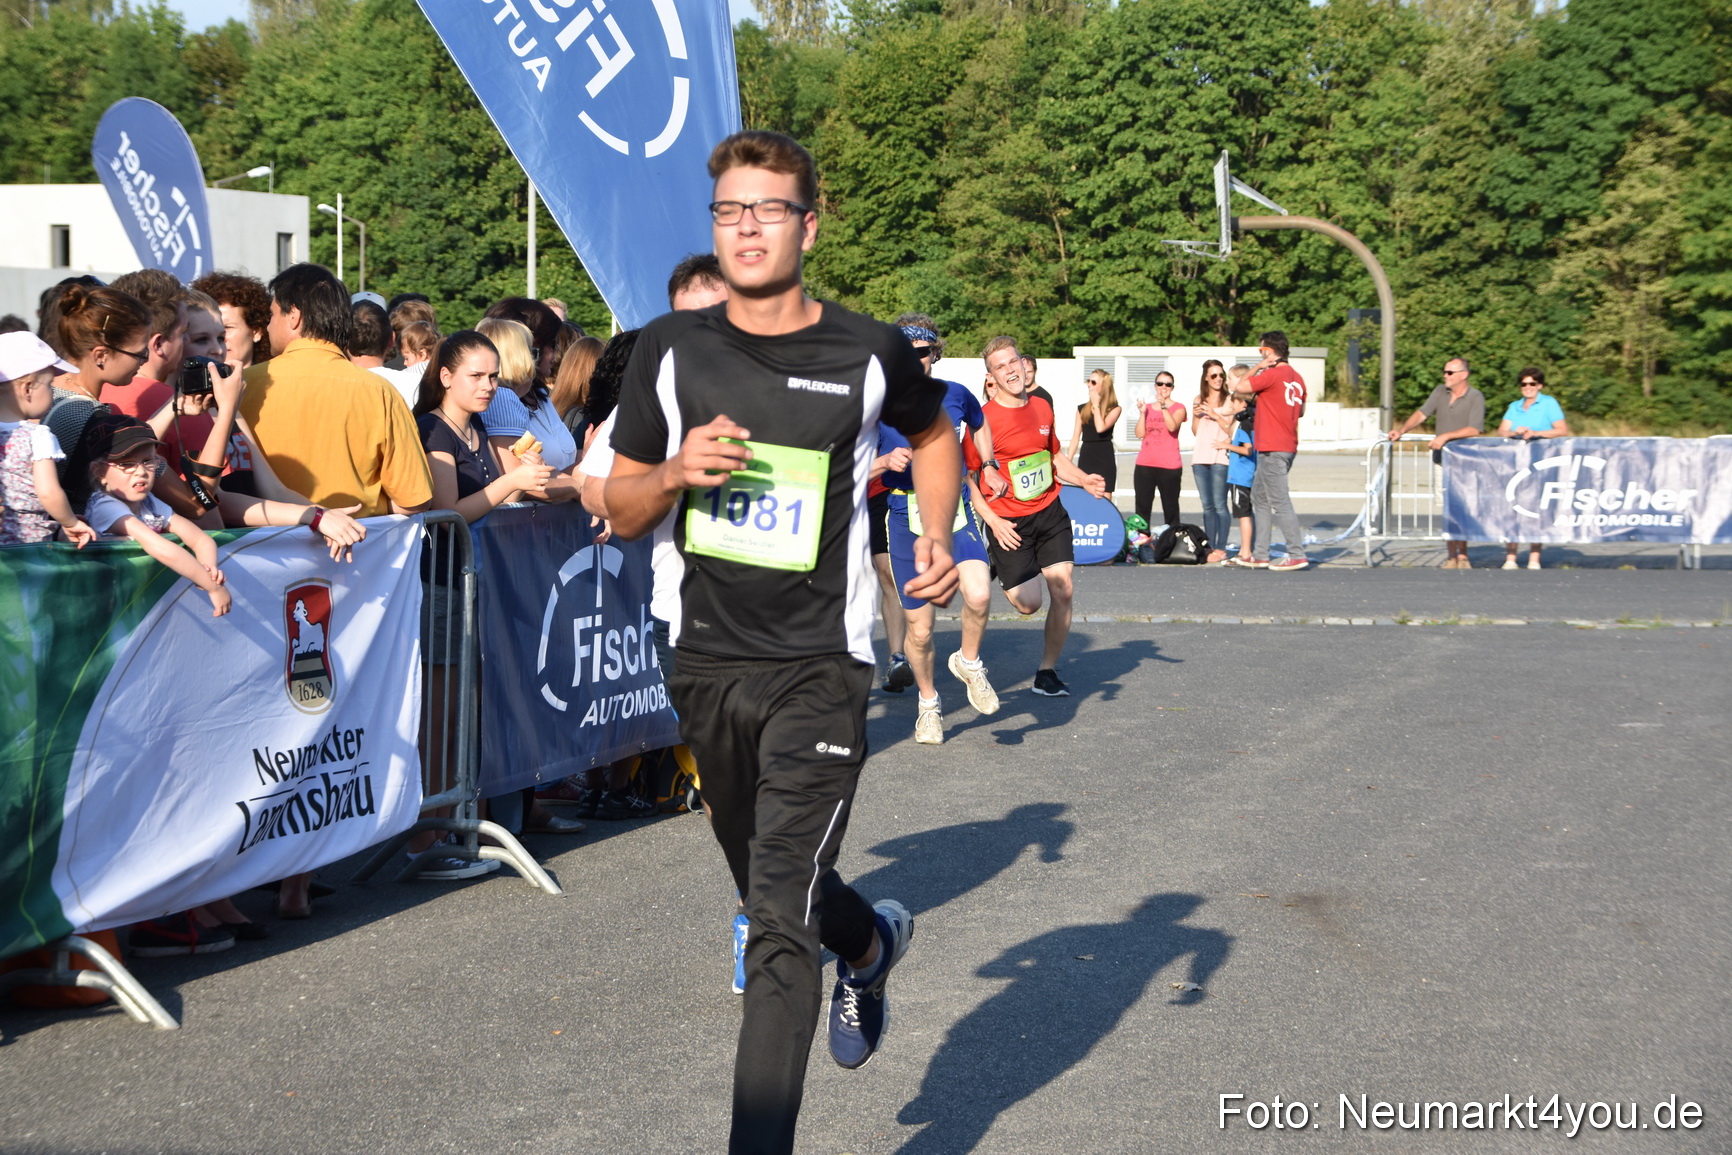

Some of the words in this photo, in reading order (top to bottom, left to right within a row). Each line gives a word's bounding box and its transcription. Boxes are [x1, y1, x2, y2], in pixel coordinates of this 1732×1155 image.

[798, 379, 851, 396] PFLEIDERER
[1020, 468, 1044, 489] 971
[191, 479, 211, 505] SONY
[1539, 481, 1698, 511] Fischer
[703, 485, 803, 535] 1081
[1553, 513, 1685, 527] AUTOMOBILE
[298, 681, 324, 702] 1628
[252, 724, 364, 785] Neumkter
